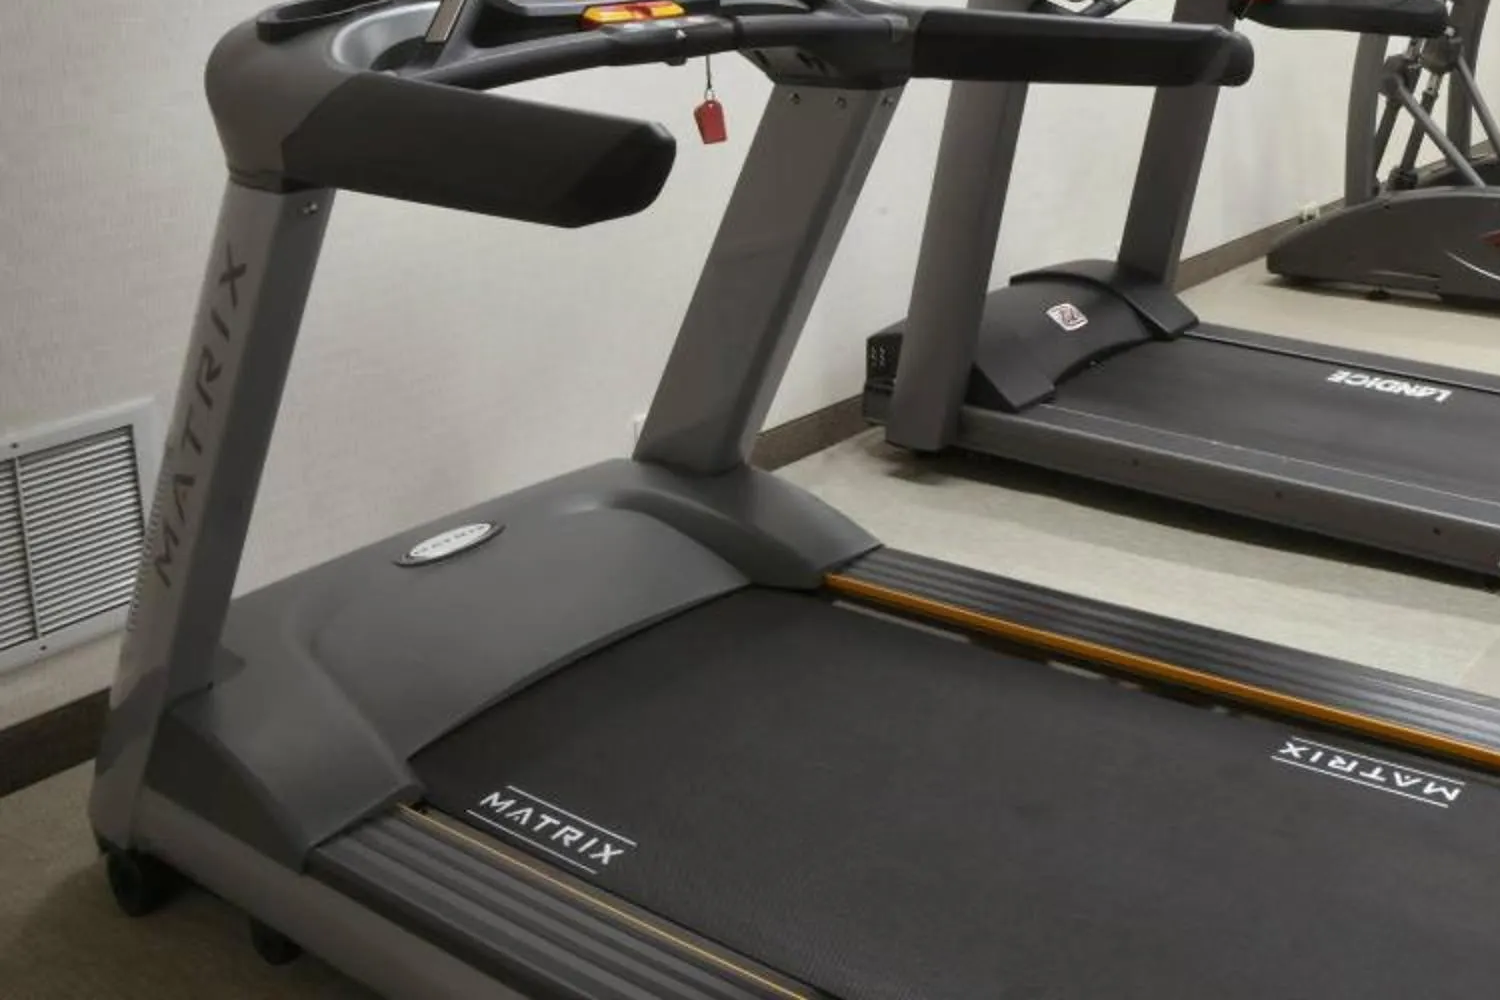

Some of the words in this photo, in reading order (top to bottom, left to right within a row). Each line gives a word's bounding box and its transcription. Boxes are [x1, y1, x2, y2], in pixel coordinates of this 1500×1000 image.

[154, 240, 248, 588] MATRIX
[1327, 369, 1453, 403] LANDICE
[1278, 741, 1462, 801] MATRIX
[479, 791, 625, 865] MATRIX
